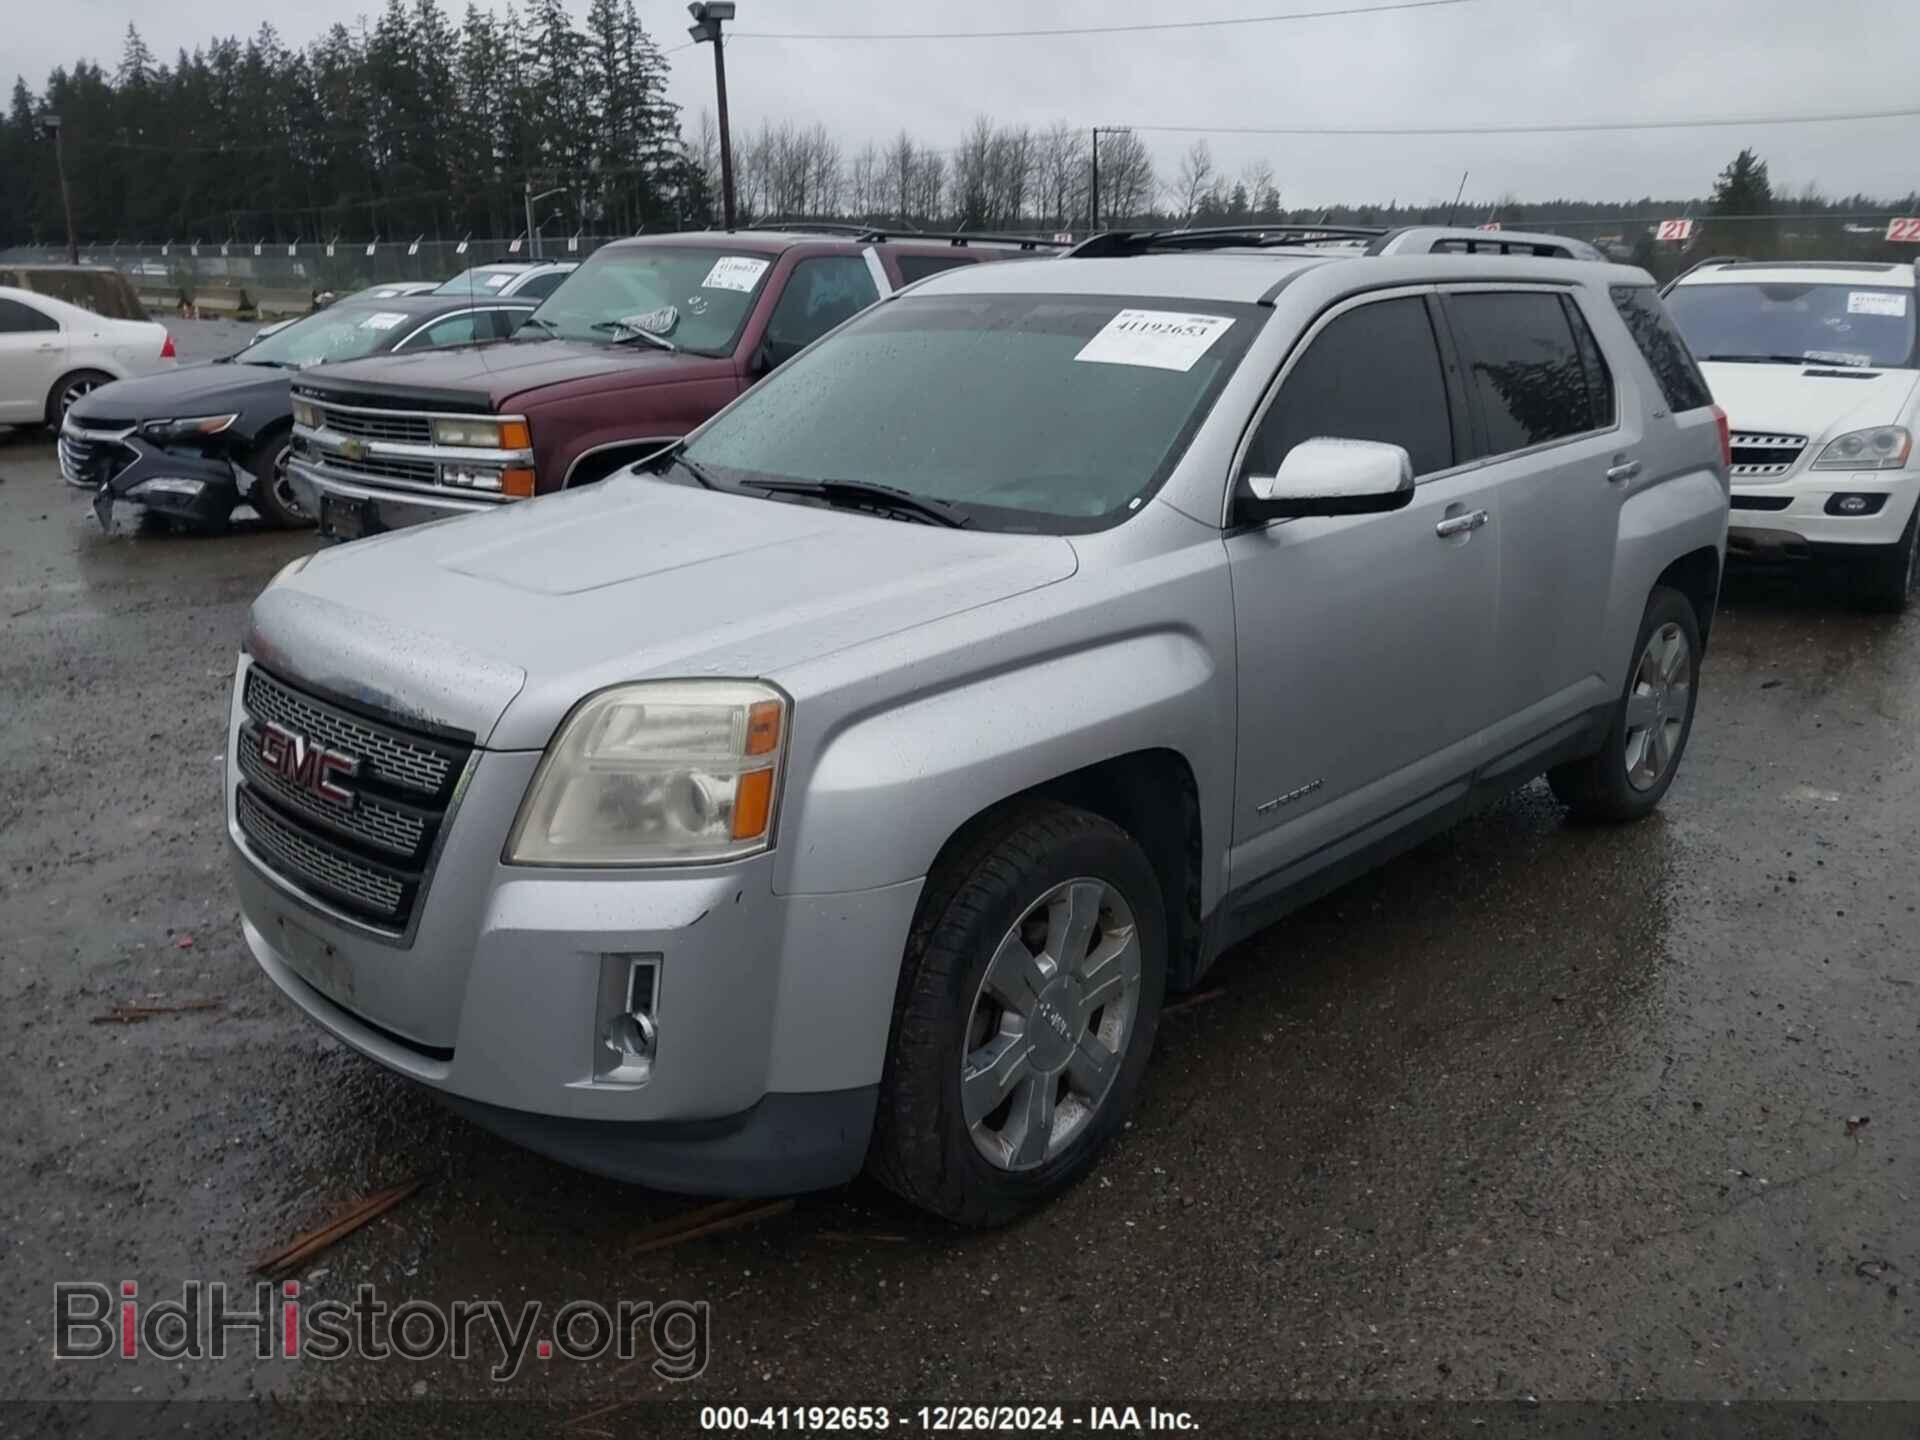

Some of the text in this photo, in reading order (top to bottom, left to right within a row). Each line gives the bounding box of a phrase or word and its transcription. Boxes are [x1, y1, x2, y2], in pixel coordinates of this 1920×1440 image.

[1663, 221, 1686, 239] 21
[1890, 220, 1920, 240] 22
[1117, 319, 1208, 337] 41192653
[257, 721, 358, 808] GMC
